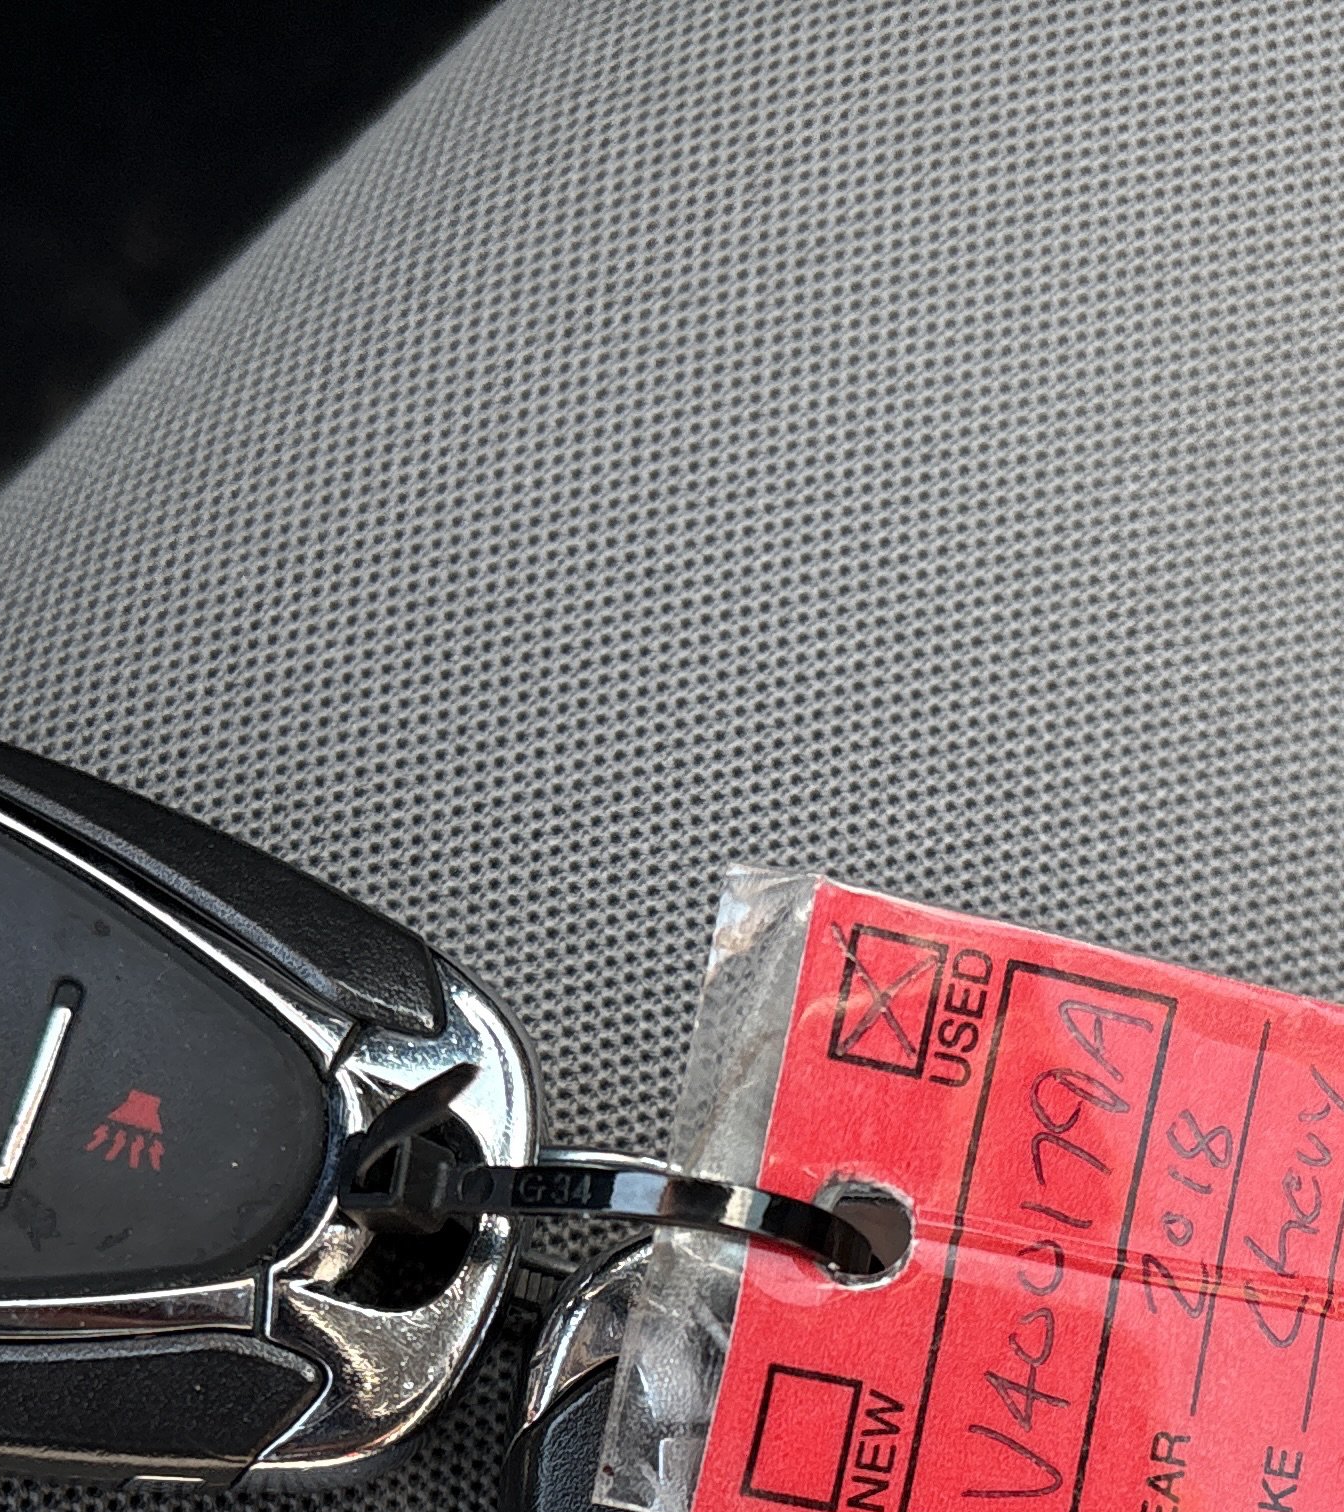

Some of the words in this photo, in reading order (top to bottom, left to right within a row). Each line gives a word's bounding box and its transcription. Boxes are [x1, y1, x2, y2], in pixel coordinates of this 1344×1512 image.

[929, 947, 994, 1088] USED
[1143, 1110, 1234, 1320] 2018
[848, 1388, 907, 1512] NEW
